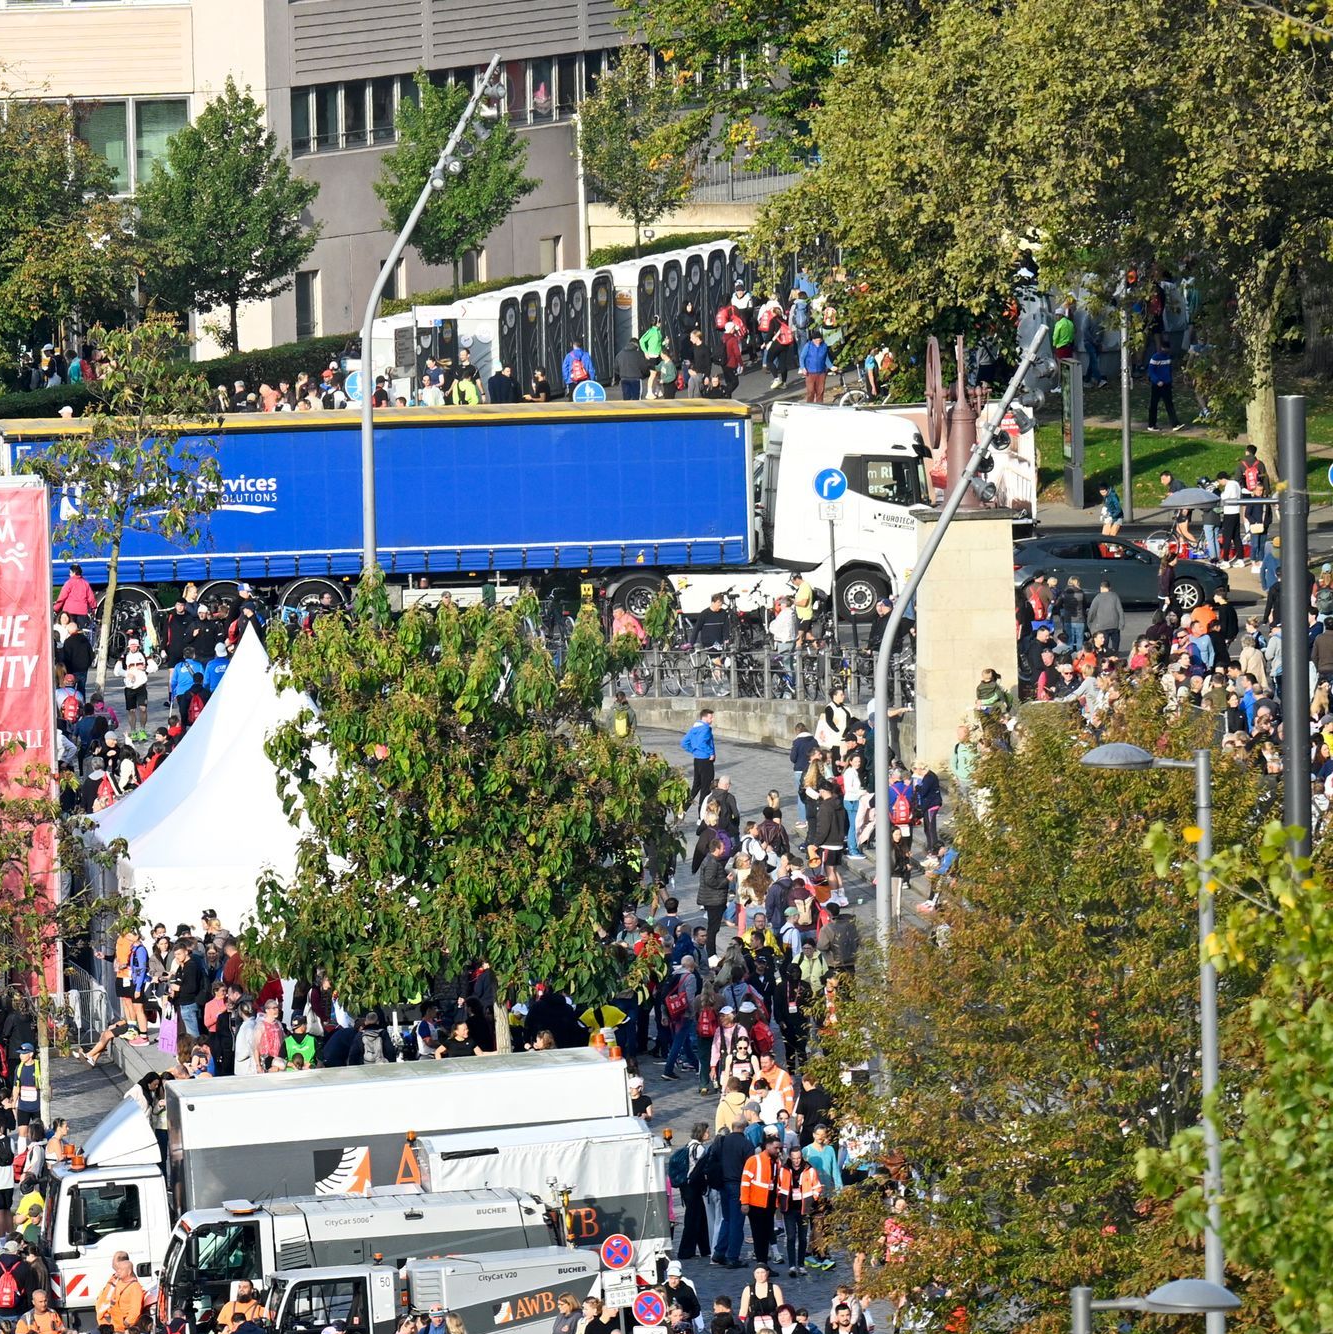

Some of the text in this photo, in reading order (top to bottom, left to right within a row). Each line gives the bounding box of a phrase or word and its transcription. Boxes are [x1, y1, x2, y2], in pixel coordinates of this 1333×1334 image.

[882, 513, 915, 525] EUROTECH
[476, 1207, 507, 1216] BUCHER
[324, 1218, 349, 1227] CityCat
[558, 1266, 587, 1275] BUCHER
[379, 1276, 391, 1288] 50
[478, 1271, 518, 1283] CityCat V20
[515, 1291, 555, 1320] AWB
